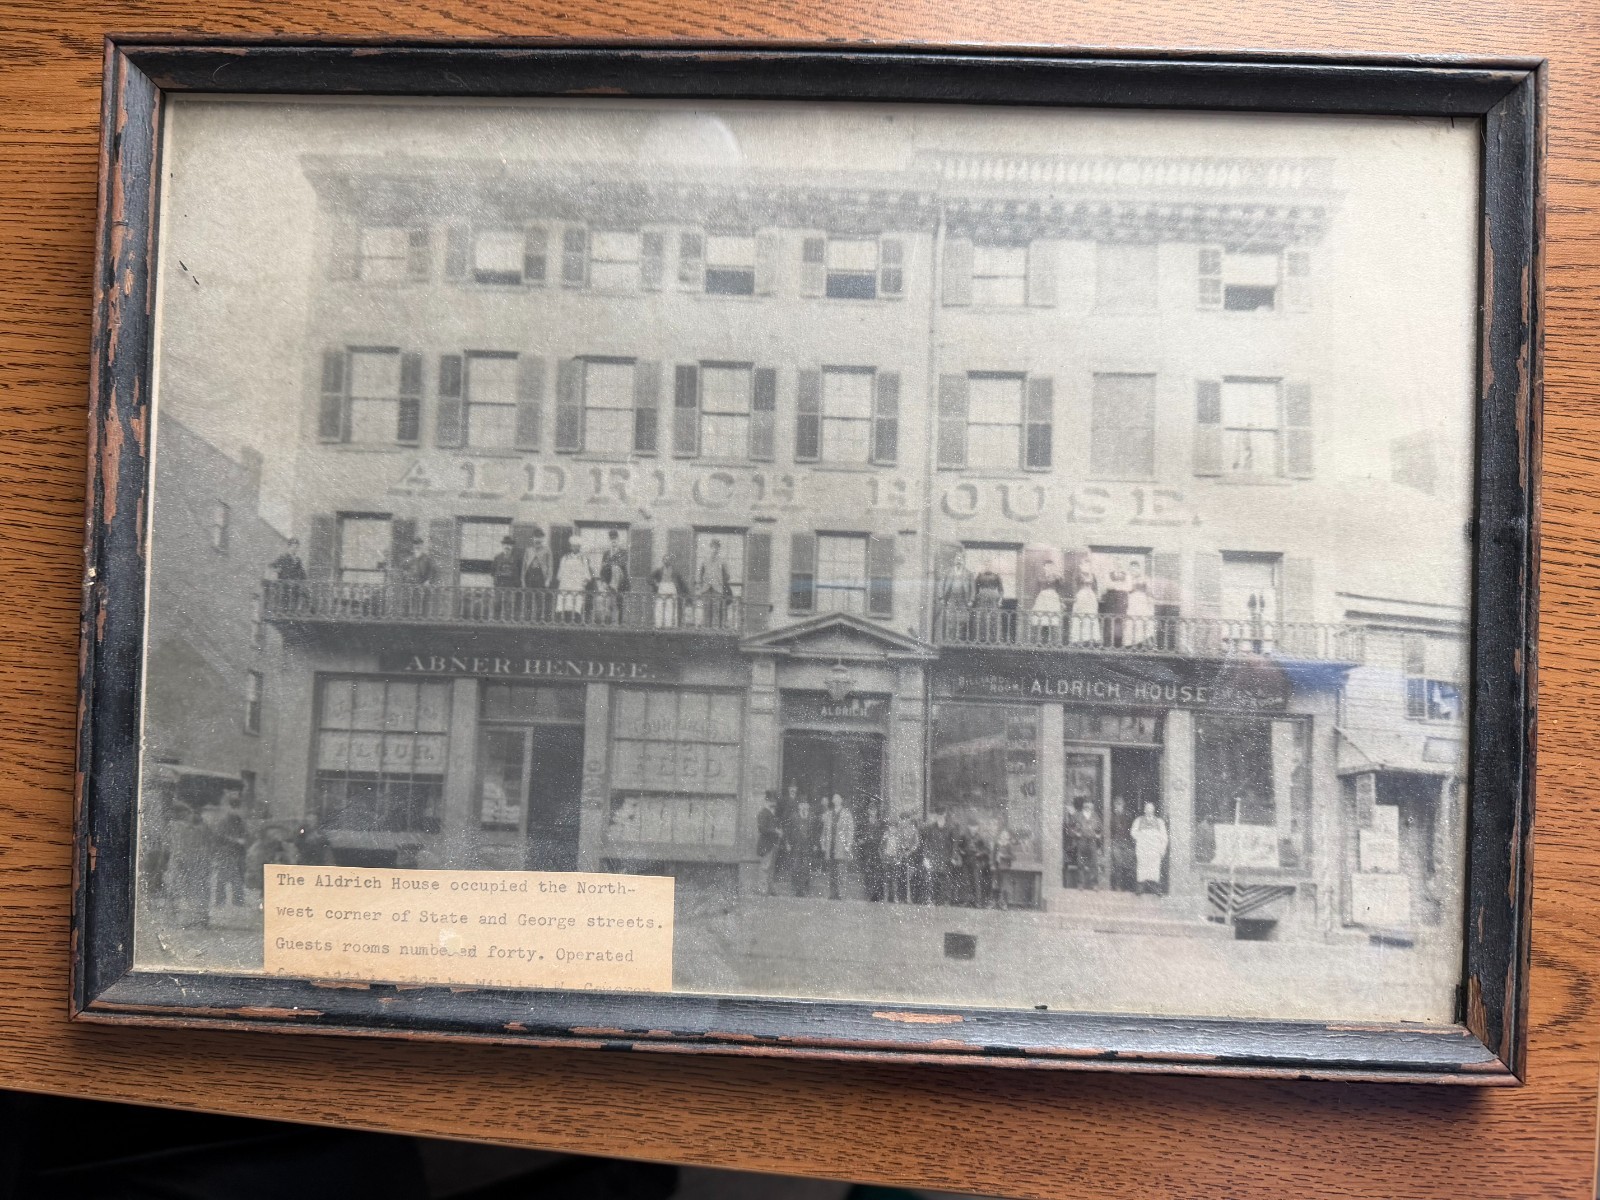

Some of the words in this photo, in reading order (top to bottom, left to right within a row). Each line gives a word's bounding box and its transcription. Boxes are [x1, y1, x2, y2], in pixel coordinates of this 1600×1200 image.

[387, 459, 802, 511] ALDRICH
[405, 656, 511, 674] ABNER
[522, 659, 657, 679] HENDEE.
[1030, 679, 1121, 698] ALDRICH
[1134, 684, 1208, 702] HOUSE
[277, 873, 305, 887] The
[315, 874, 382, 889] Aldrich
[392, 877, 440, 891] House
[450, 880, 528, 895] occupied
[539, 880, 568, 893] the
[577, 881, 636, 895] North-
[276, 906, 314, 918] west
[325, 909, 382, 921] corner
[392, 909, 411, 922] of
[419, 910, 469, 924] State
[478, 913, 507, 926] and
[518, 913, 576, 930] George
[586, 915, 663, 929] streets.
[275, 937, 332, 951] Guests
[342, 942, 390, 955] rooms
[400, 943, 478, 958] numbeed
[487, 945, 545, 961] forty.
[555, 947, 634, 963] Operated
